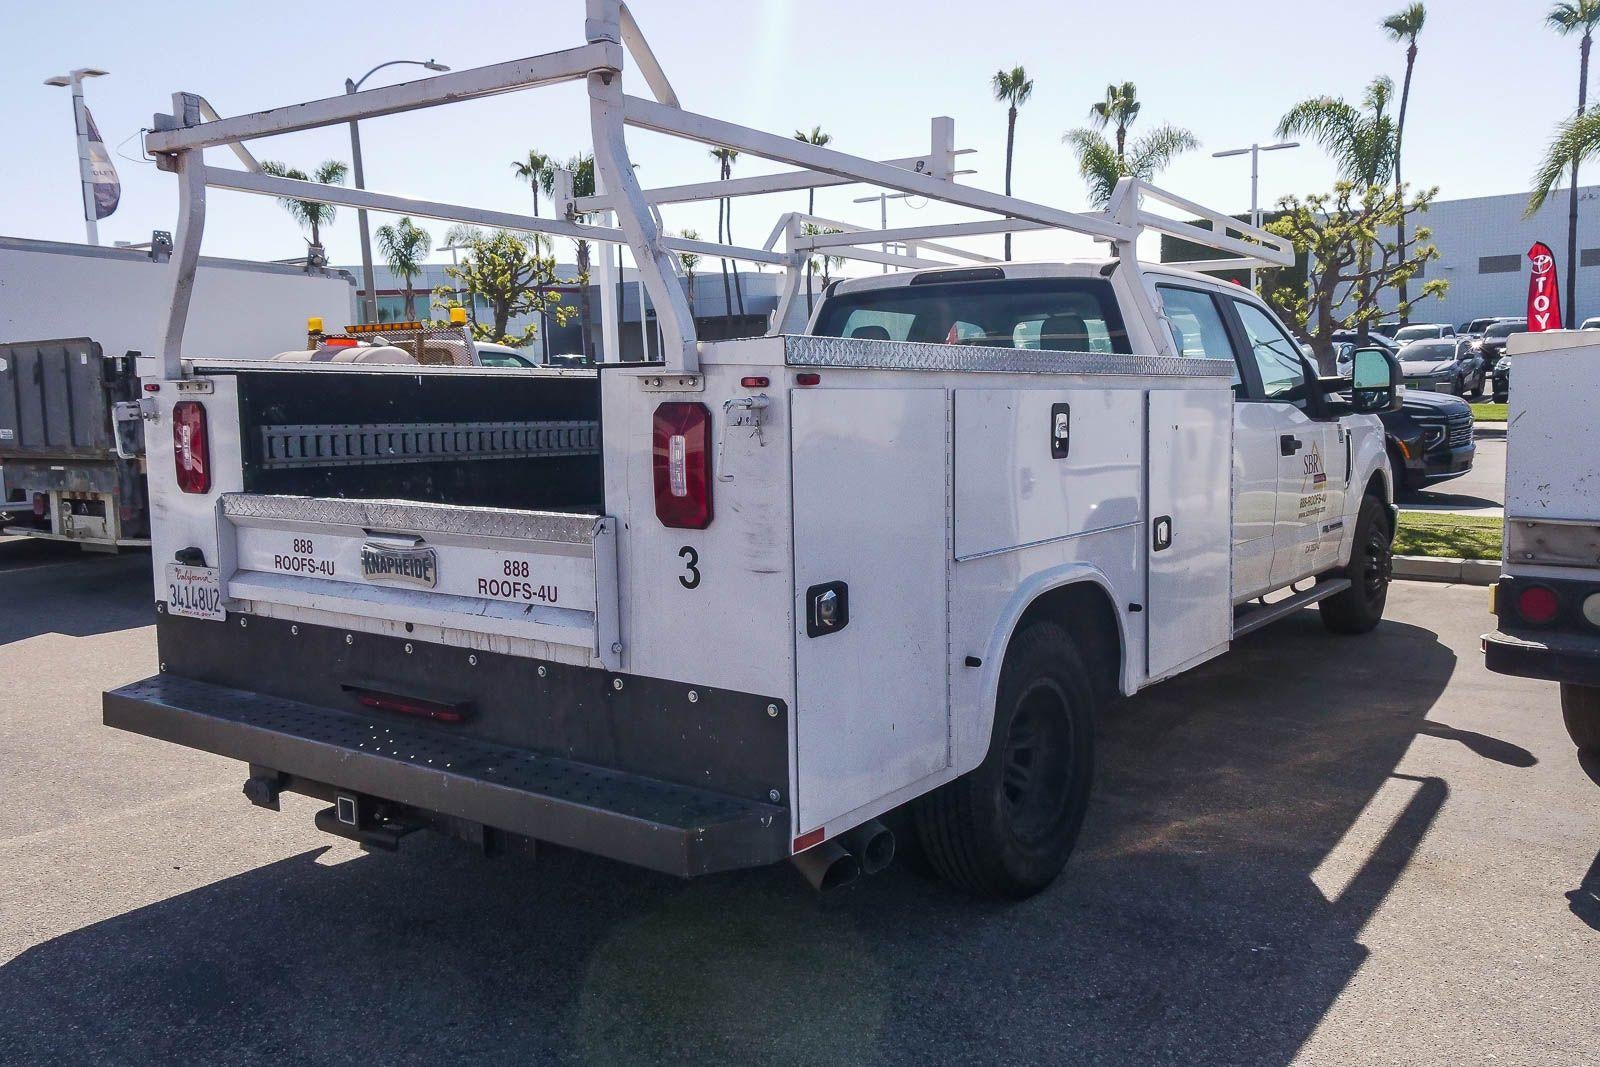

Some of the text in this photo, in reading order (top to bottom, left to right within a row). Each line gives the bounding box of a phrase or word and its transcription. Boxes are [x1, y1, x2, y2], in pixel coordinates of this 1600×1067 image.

[1533, 276, 1550, 330] TOY
[1303, 454, 1319, 475] SBR
[293, 538, 314, 554] 888
[274, 554, 335, 576] ROOFS-4U
[363, 551, 432, 582] KNAPHEIDE
[503, 559, 530, 578] 888
[678, 545, 701, 589] 3
[169, 584, 221, 612] 34148U2
[478, 578, 558, 603] ROOFS-4U
